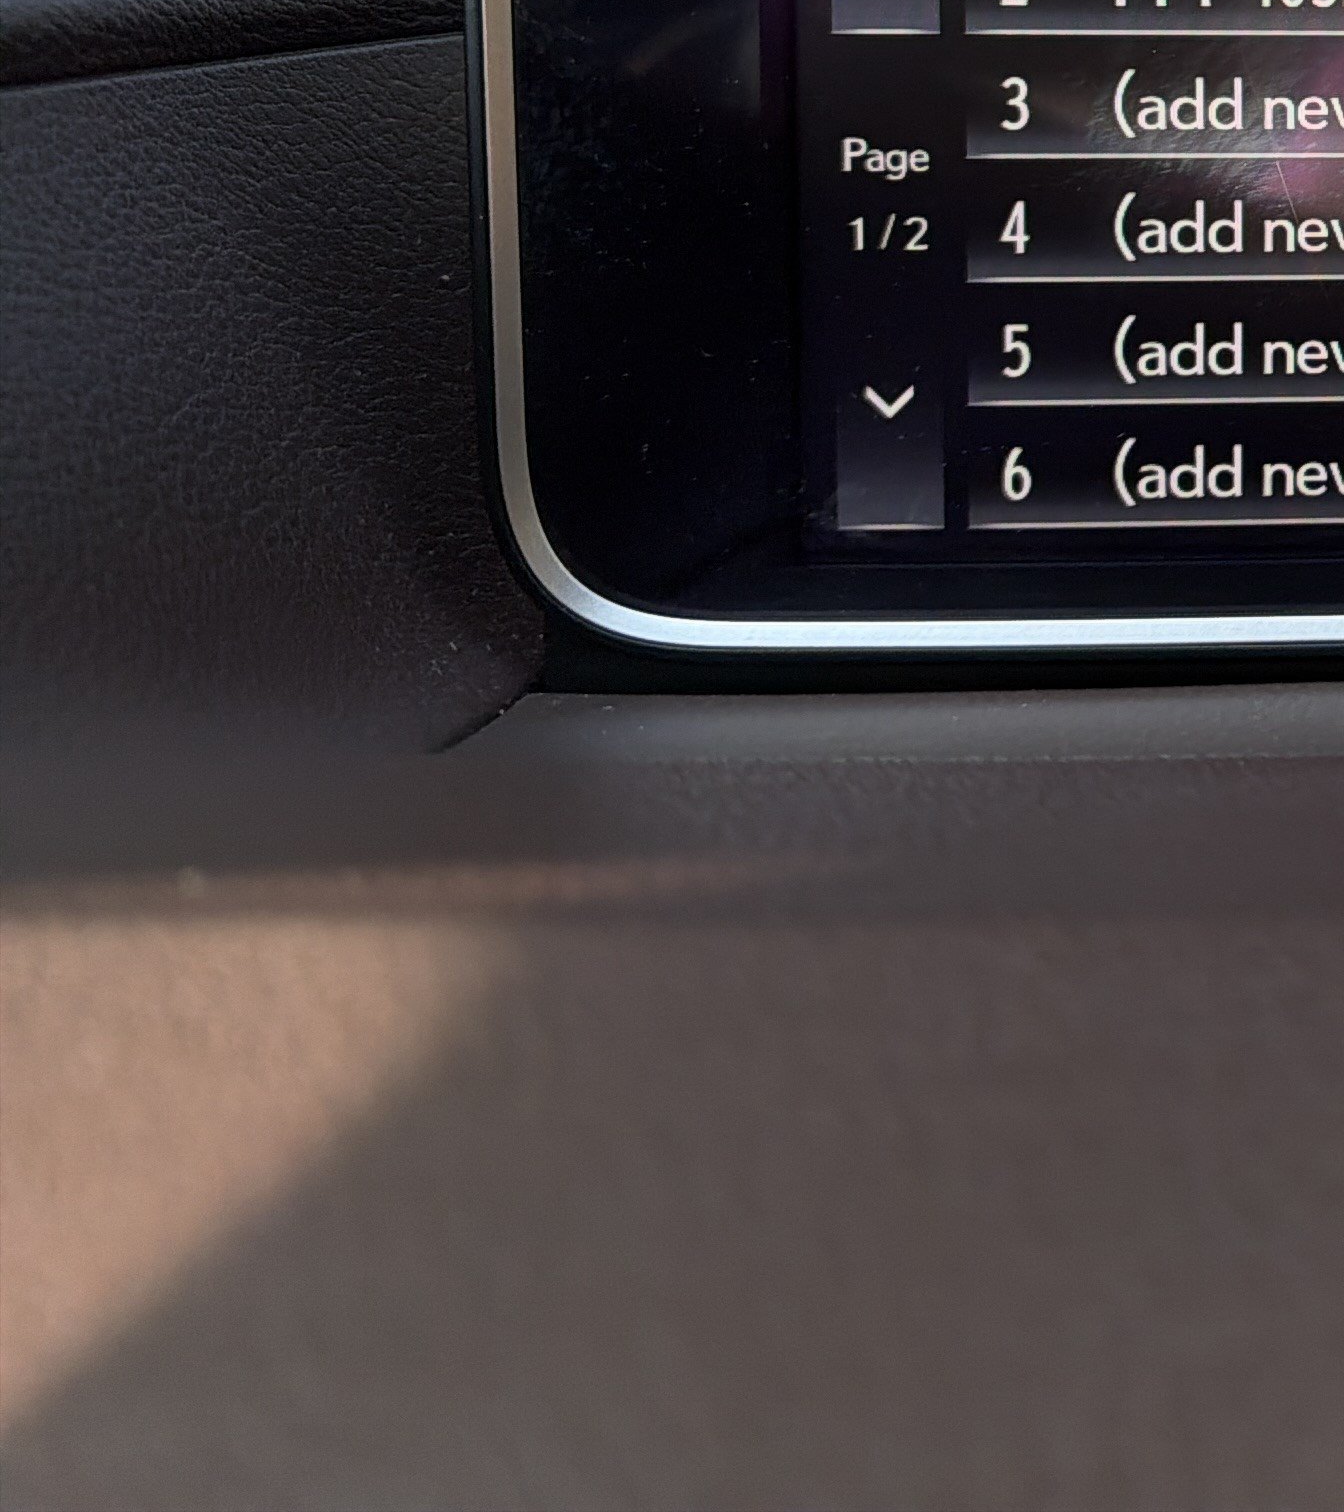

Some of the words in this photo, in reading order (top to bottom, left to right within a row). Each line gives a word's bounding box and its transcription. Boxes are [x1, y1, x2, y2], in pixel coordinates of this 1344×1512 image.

[999, 76, 1031, 131] 3
[1113, 69, 1243, 138] (add
[839, 137, 930, 180] Page
[846, 213, 930, 252] 1/2
[999, 200, 1031, 254] 4
[1113, 191, 1243, 262] (add
[1001, 323, 1032, 377] 5
[1113, 314, 1243, 384] (add
[1002, 446, 1032, 501] 6
[1113, 437, 1243, 507] (add
